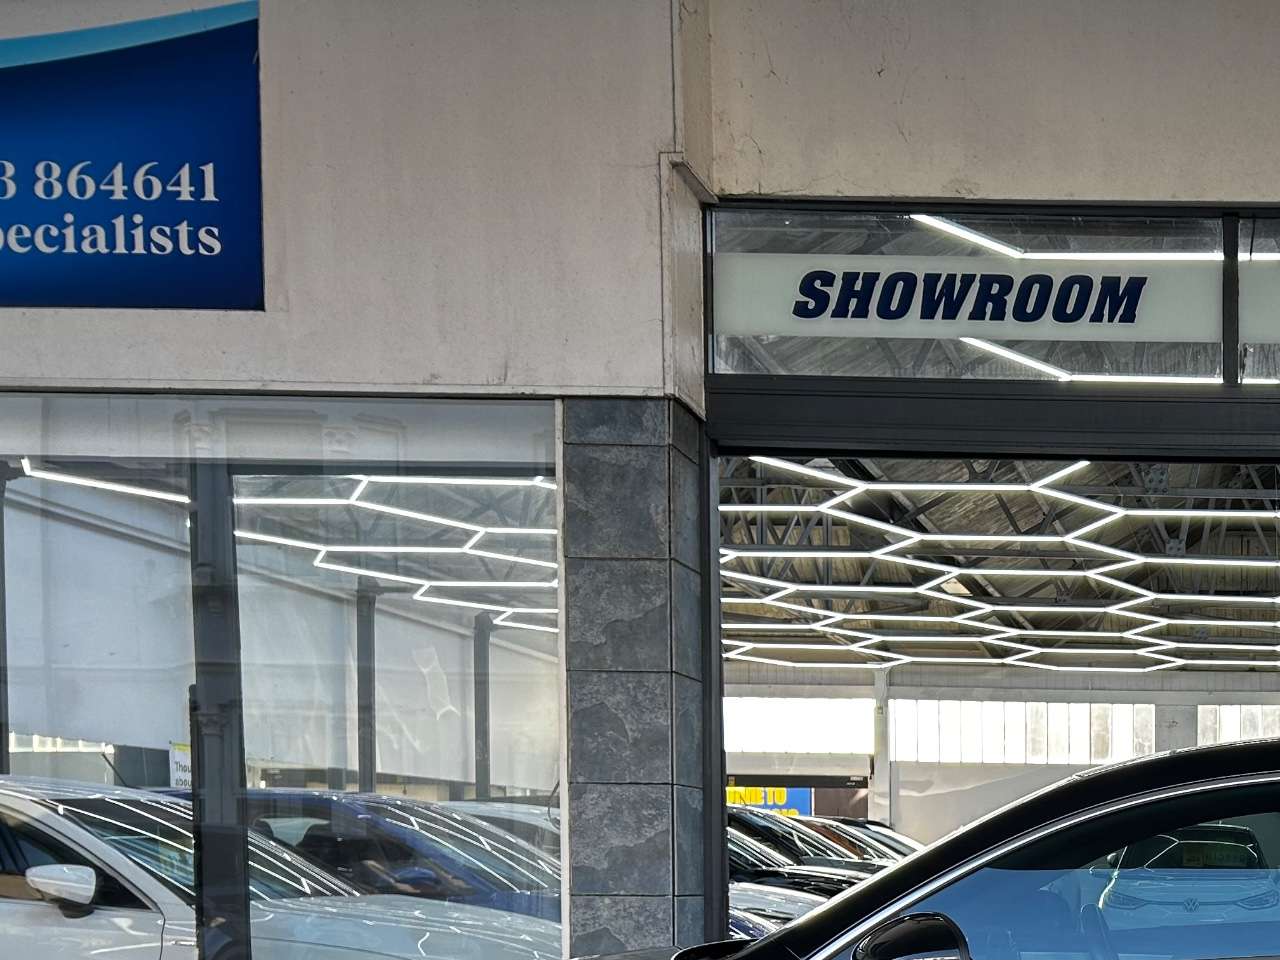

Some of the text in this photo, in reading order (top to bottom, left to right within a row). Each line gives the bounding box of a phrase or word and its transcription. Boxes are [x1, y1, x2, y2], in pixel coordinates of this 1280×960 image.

[34, 160, 220, 202] 864641
[0, 212, 222, 256] ecialists
[792, 270, 1148, 324] SHOWROOM
